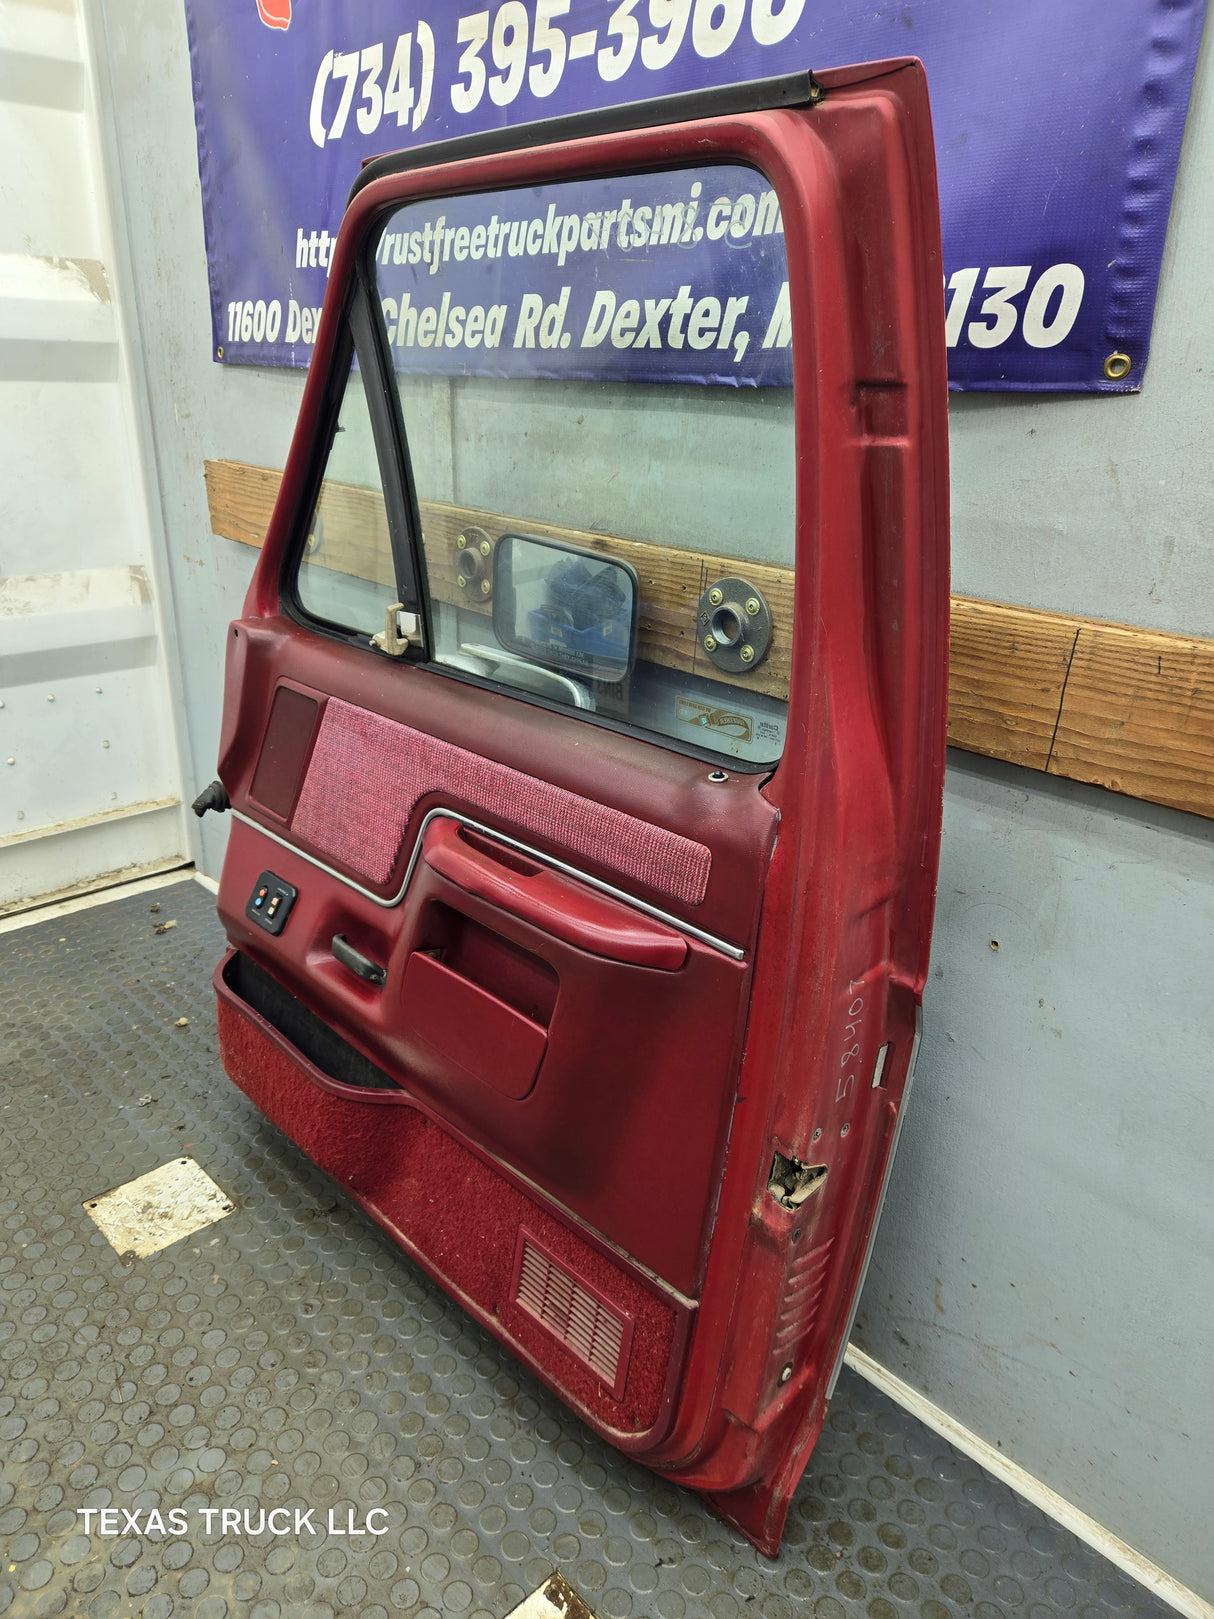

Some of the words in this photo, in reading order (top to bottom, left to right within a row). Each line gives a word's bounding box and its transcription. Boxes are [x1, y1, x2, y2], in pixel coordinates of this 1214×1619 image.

[309, 20, 436, 149] (734)
[227, 300, 282, 343] 11600
[381, 291, 507, 348] Chelsea
[512, 286, 571, 349] Rd.
[580, 285, 750, 363] Dexter,
[942, 263, 1085, 348] 130
[835, 979, 865, 1103] 58407
